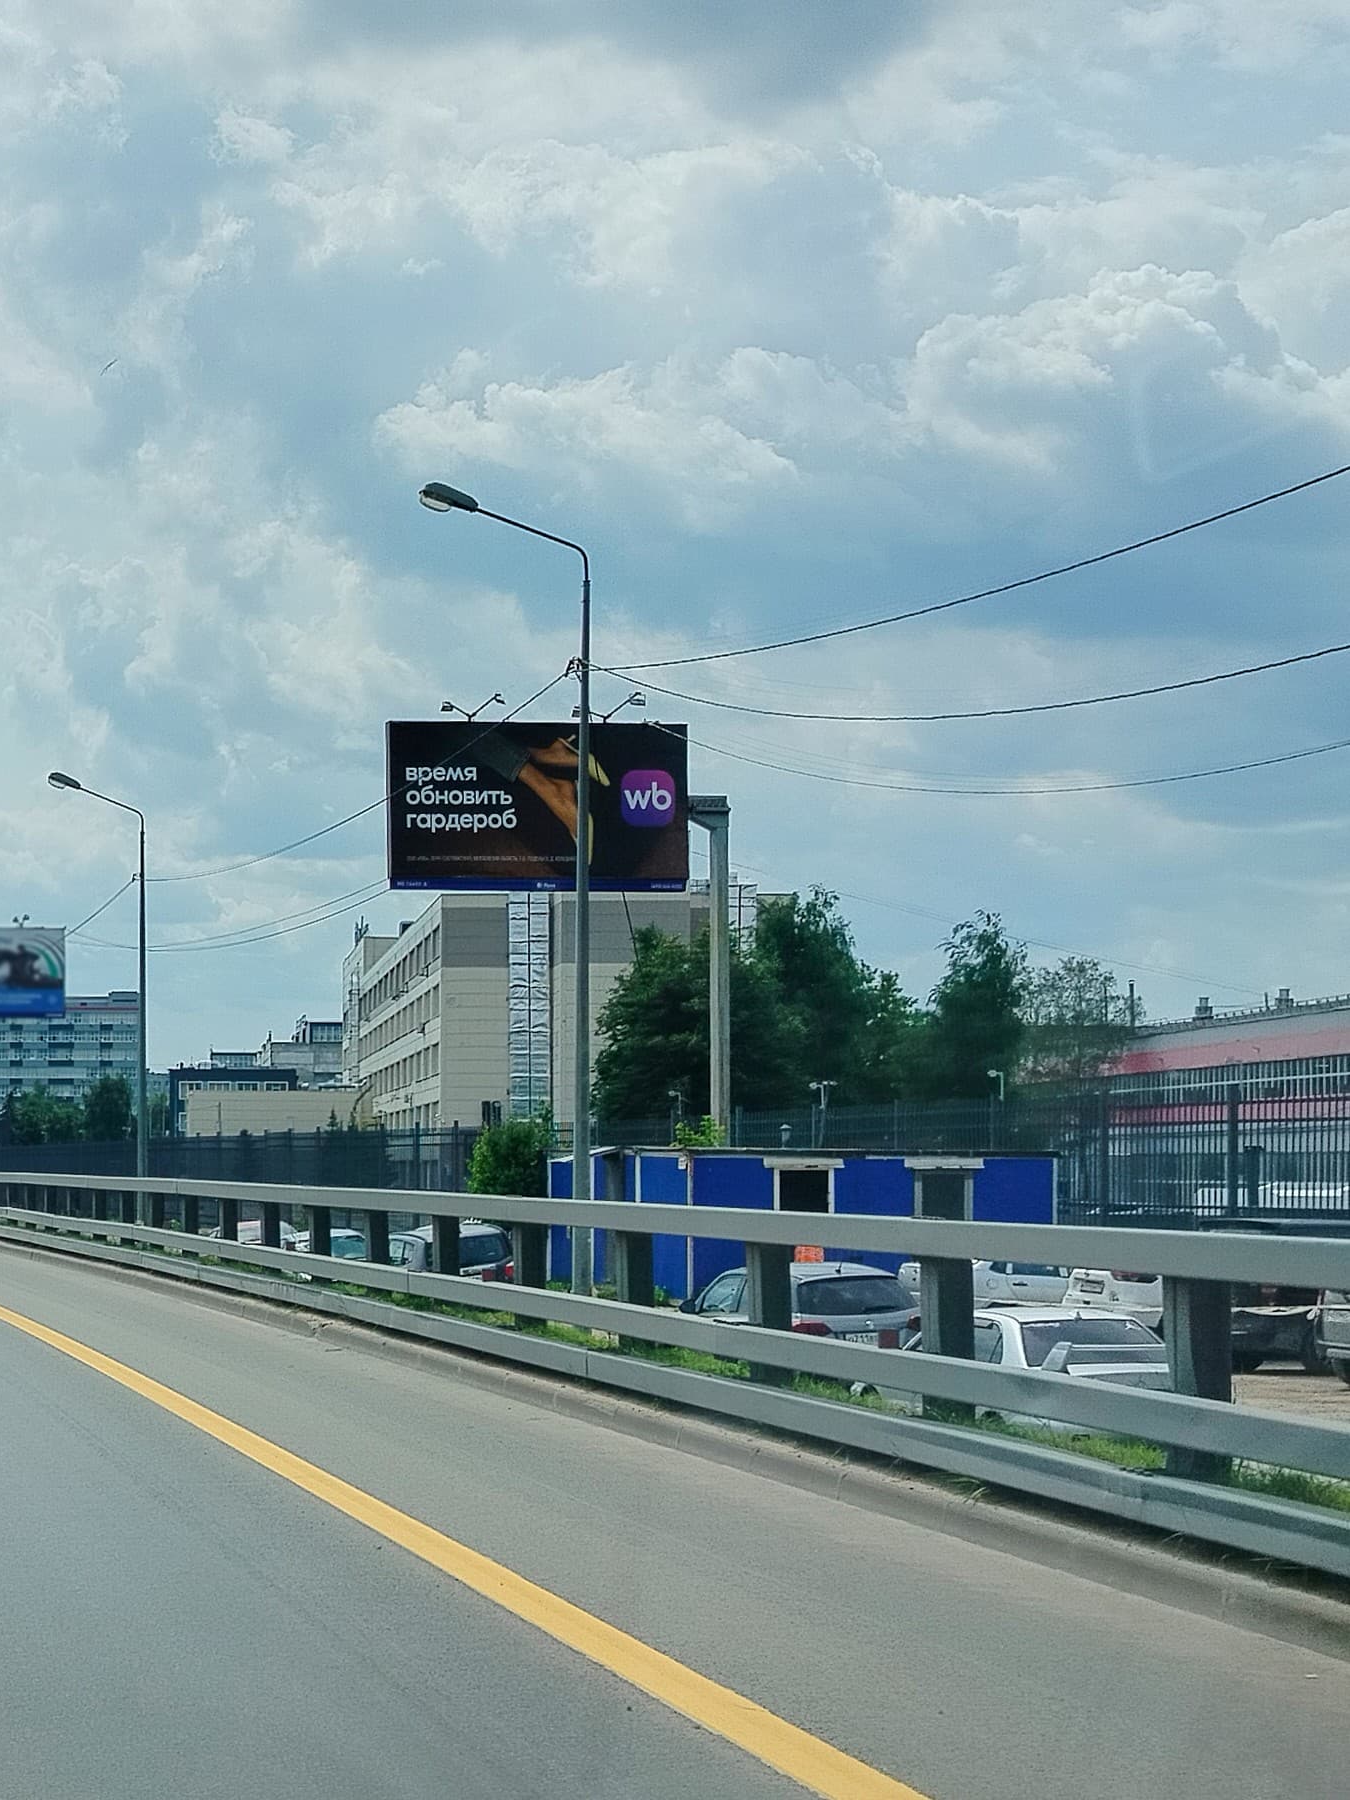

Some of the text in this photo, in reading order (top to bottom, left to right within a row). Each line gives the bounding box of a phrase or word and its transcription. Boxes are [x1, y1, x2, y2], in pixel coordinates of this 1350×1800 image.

[405, 766, 477, 786] время
[405, 784, 513, 805] обновить
[623, 781, 672, 811] wb
[406, 807, 518, 833] гардероб
